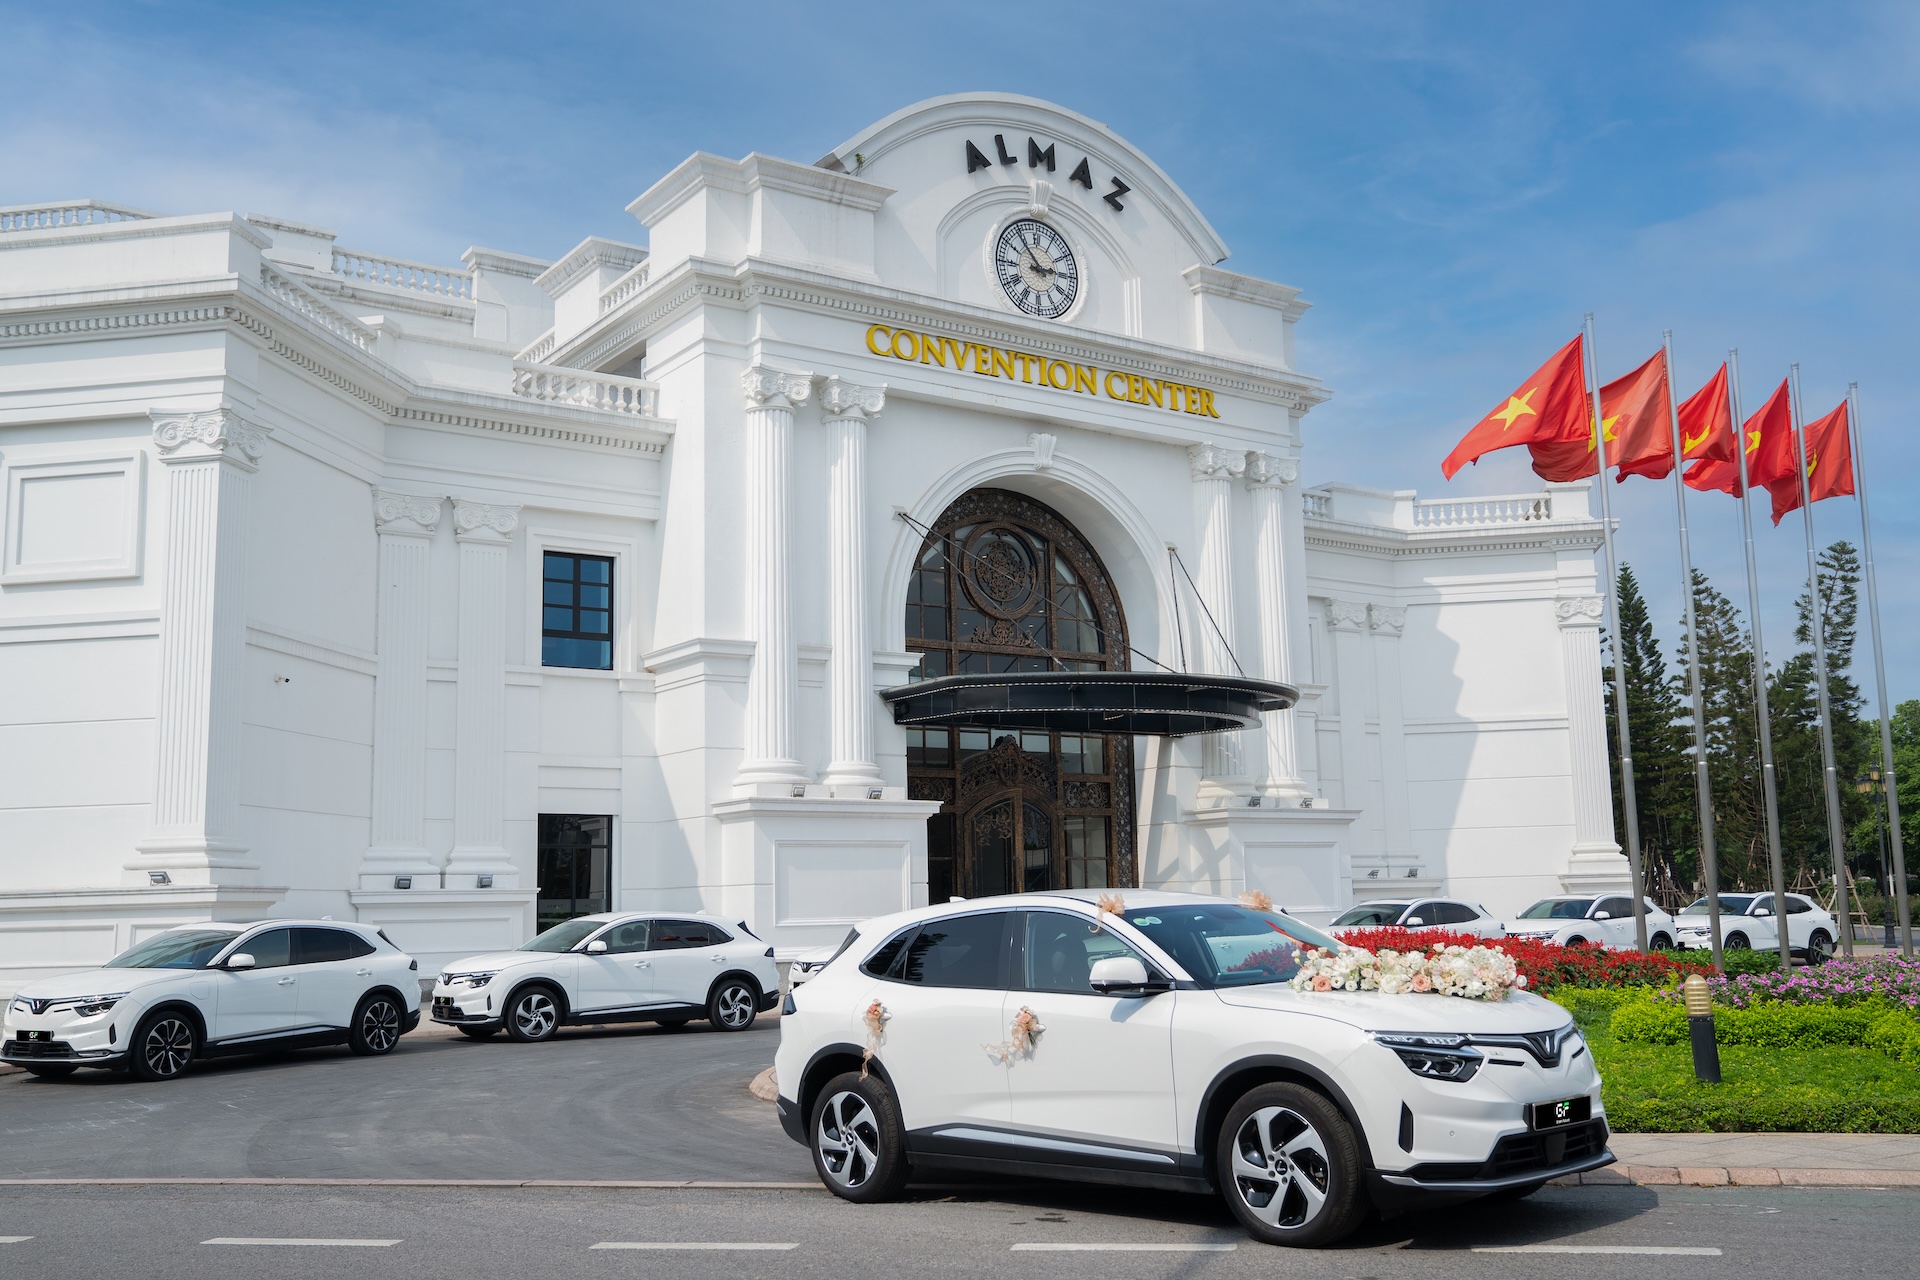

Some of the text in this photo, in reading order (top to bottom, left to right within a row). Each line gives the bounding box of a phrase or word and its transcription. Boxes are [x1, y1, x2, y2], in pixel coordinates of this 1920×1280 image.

[966, 134, 1132, 212] ALMAZ
[865, 324, 1221, 419] CONVENTION CENTER
